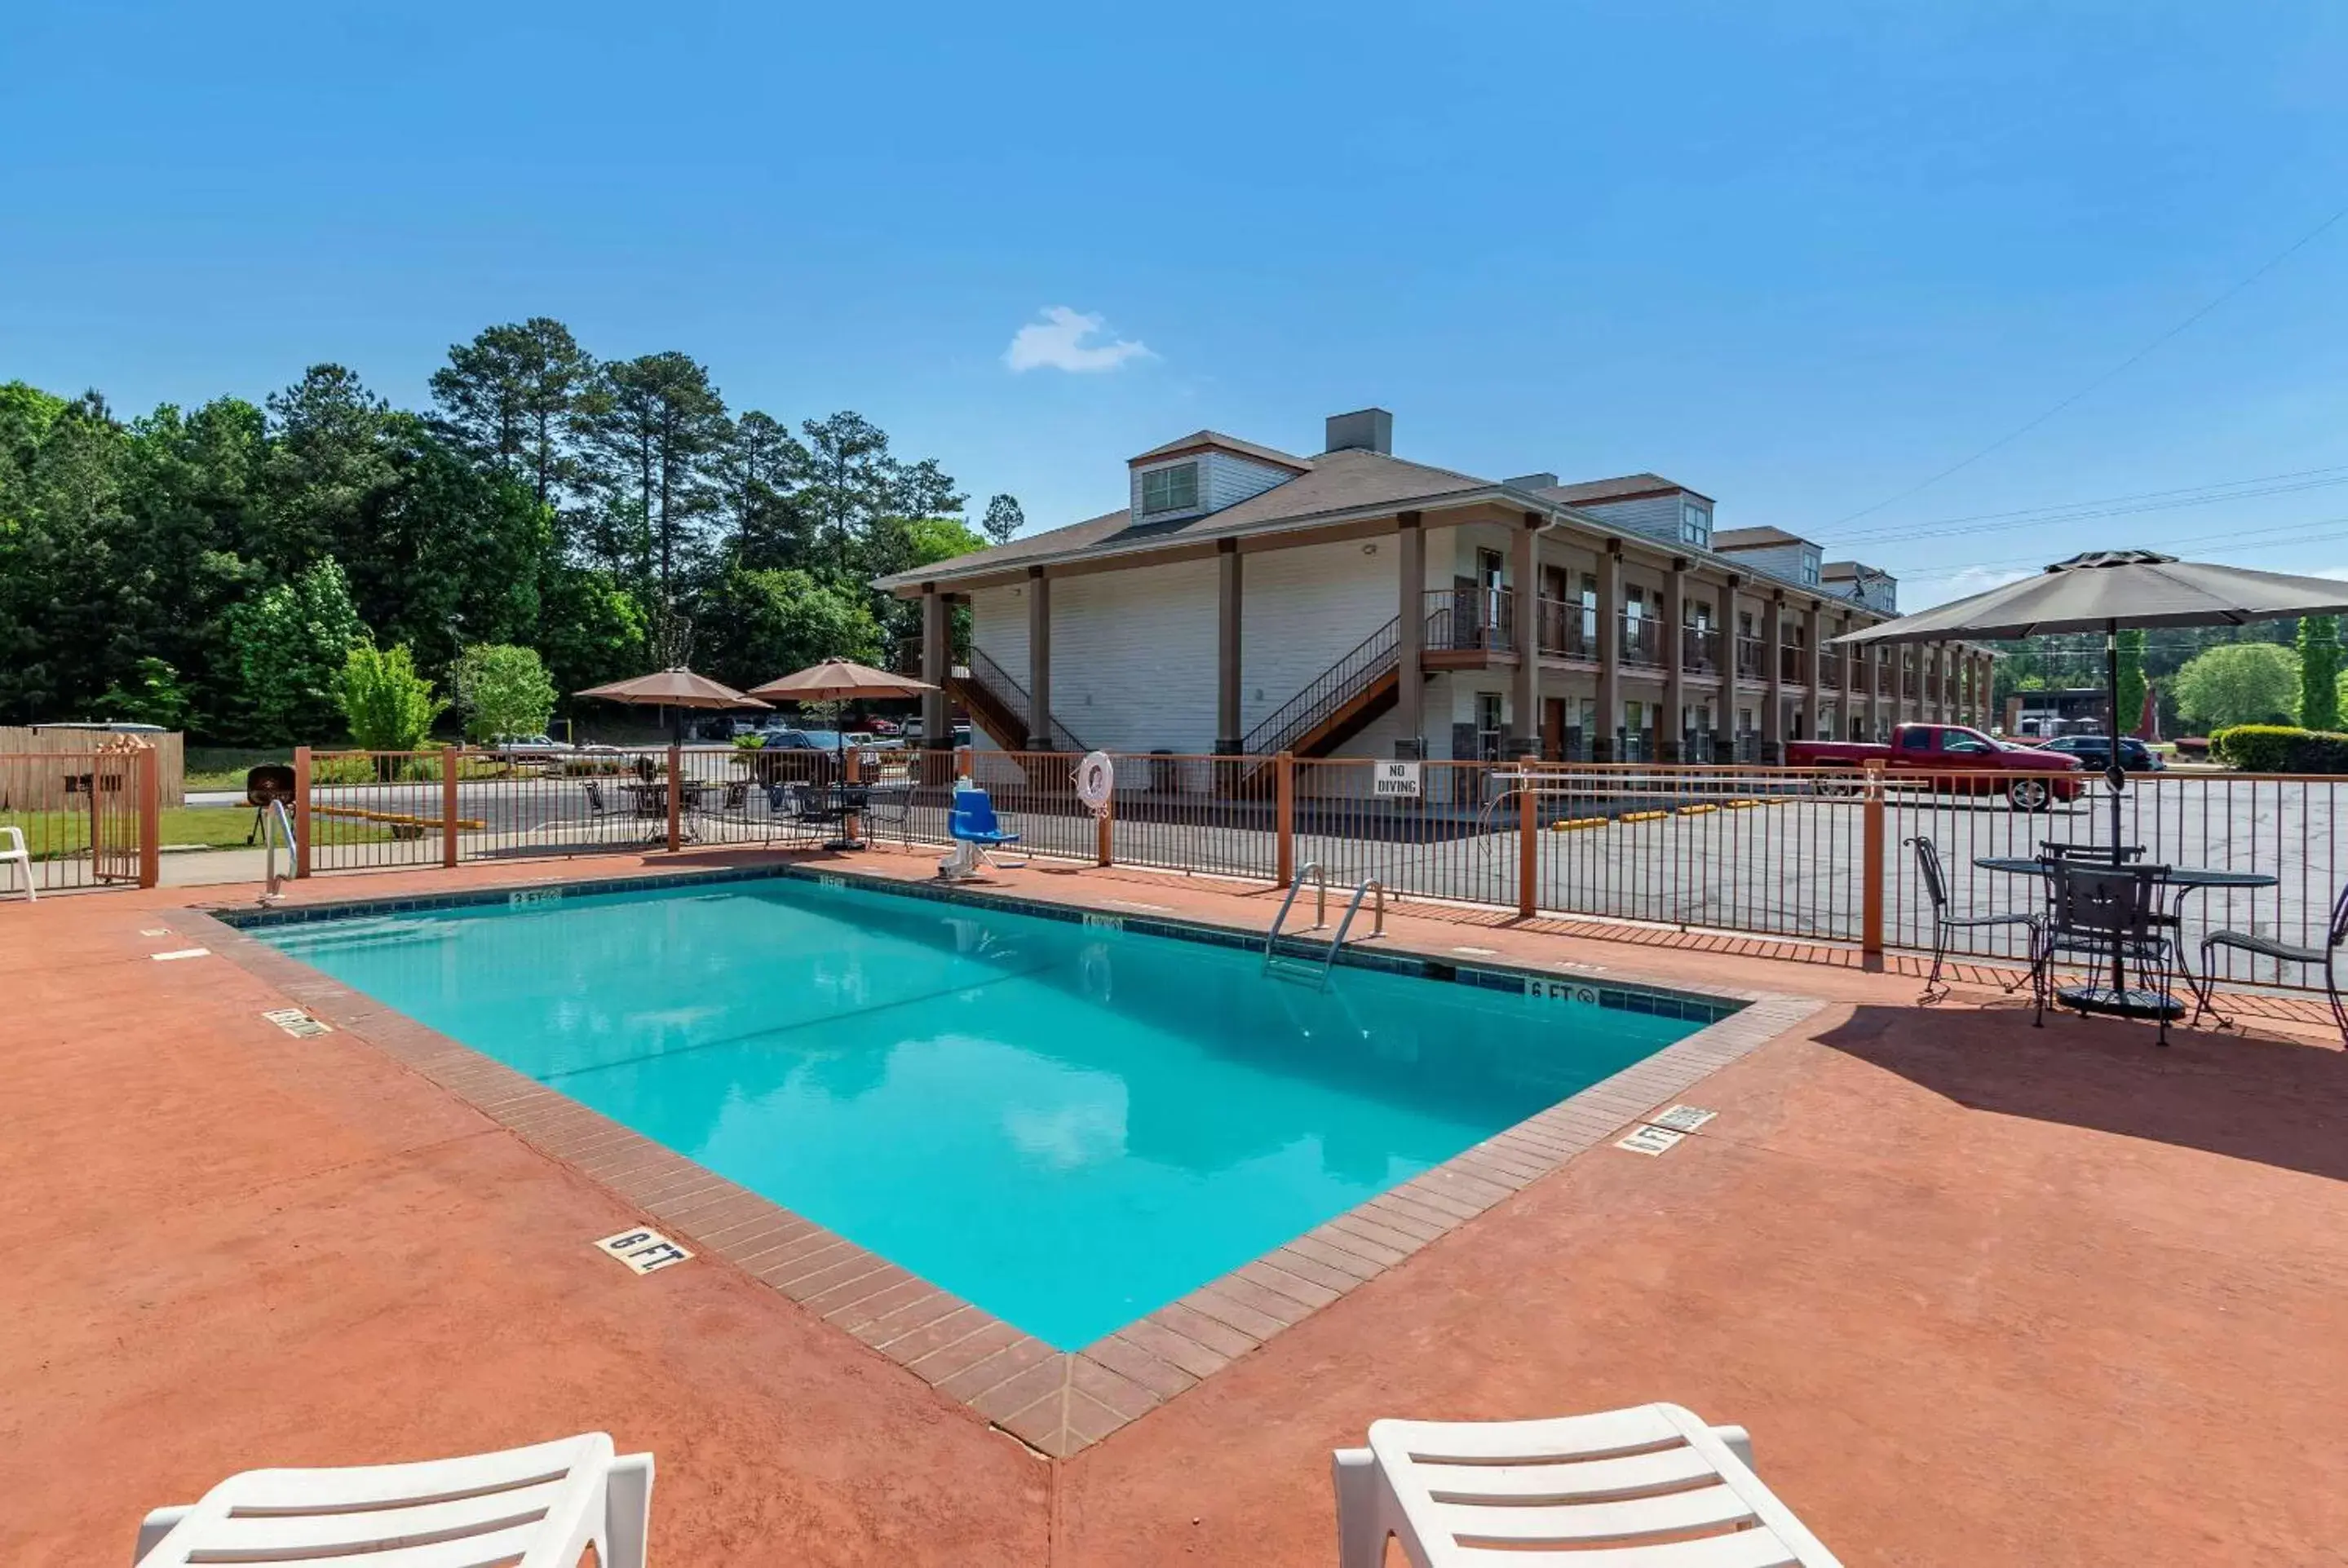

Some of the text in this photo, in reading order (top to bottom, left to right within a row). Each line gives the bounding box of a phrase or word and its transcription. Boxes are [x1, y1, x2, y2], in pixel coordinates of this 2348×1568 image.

[1389, 765, 1405, 777] NO
[1378, 780, 1417, 793] DIVING
[1532, 981, 1573, 1001] 6 FT
[627, 1242, 686, 1270] FT
